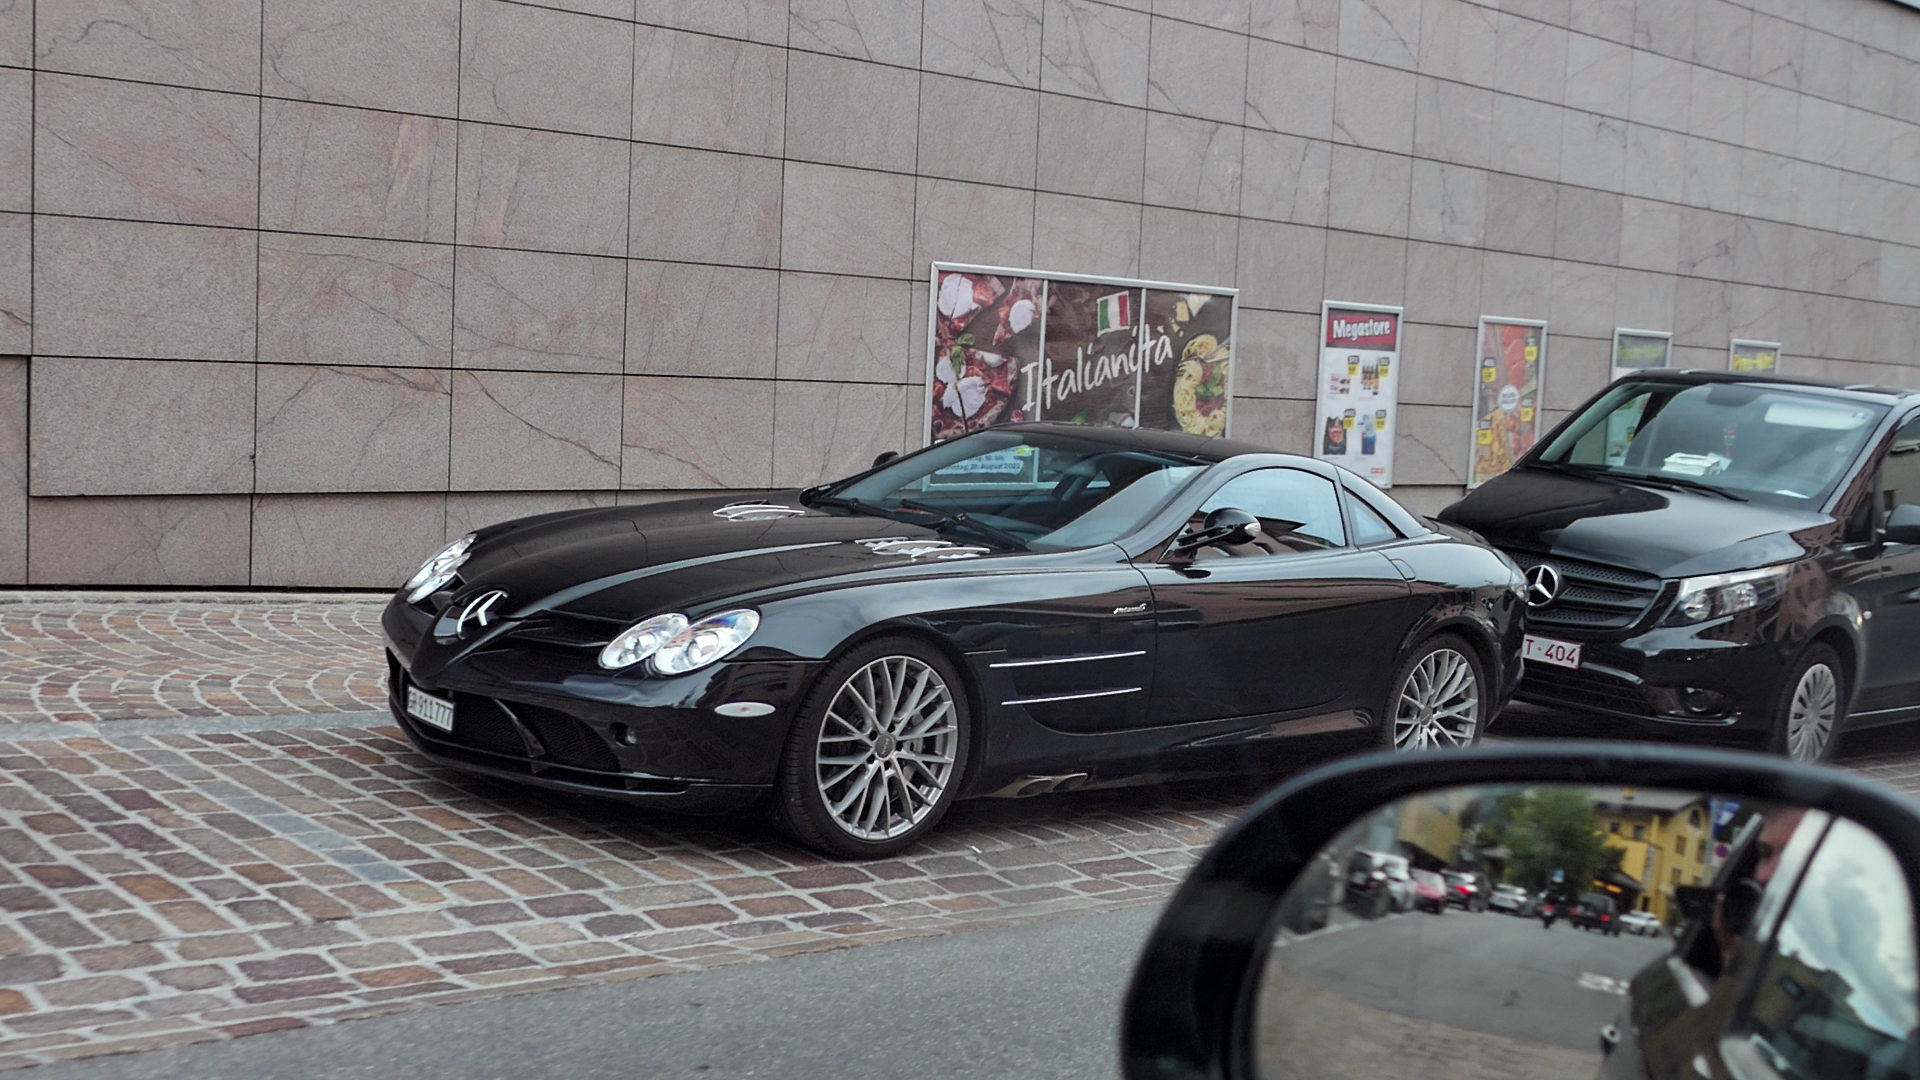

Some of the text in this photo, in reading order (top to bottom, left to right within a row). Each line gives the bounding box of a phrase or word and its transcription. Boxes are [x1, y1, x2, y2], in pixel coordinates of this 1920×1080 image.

[1332, 318, 1391, 341] Megastore
[1020, 323, 1174, 412] Italianità
[981, 463, 1002, 471] August
[1003, 462, 1020, 470] 2022
